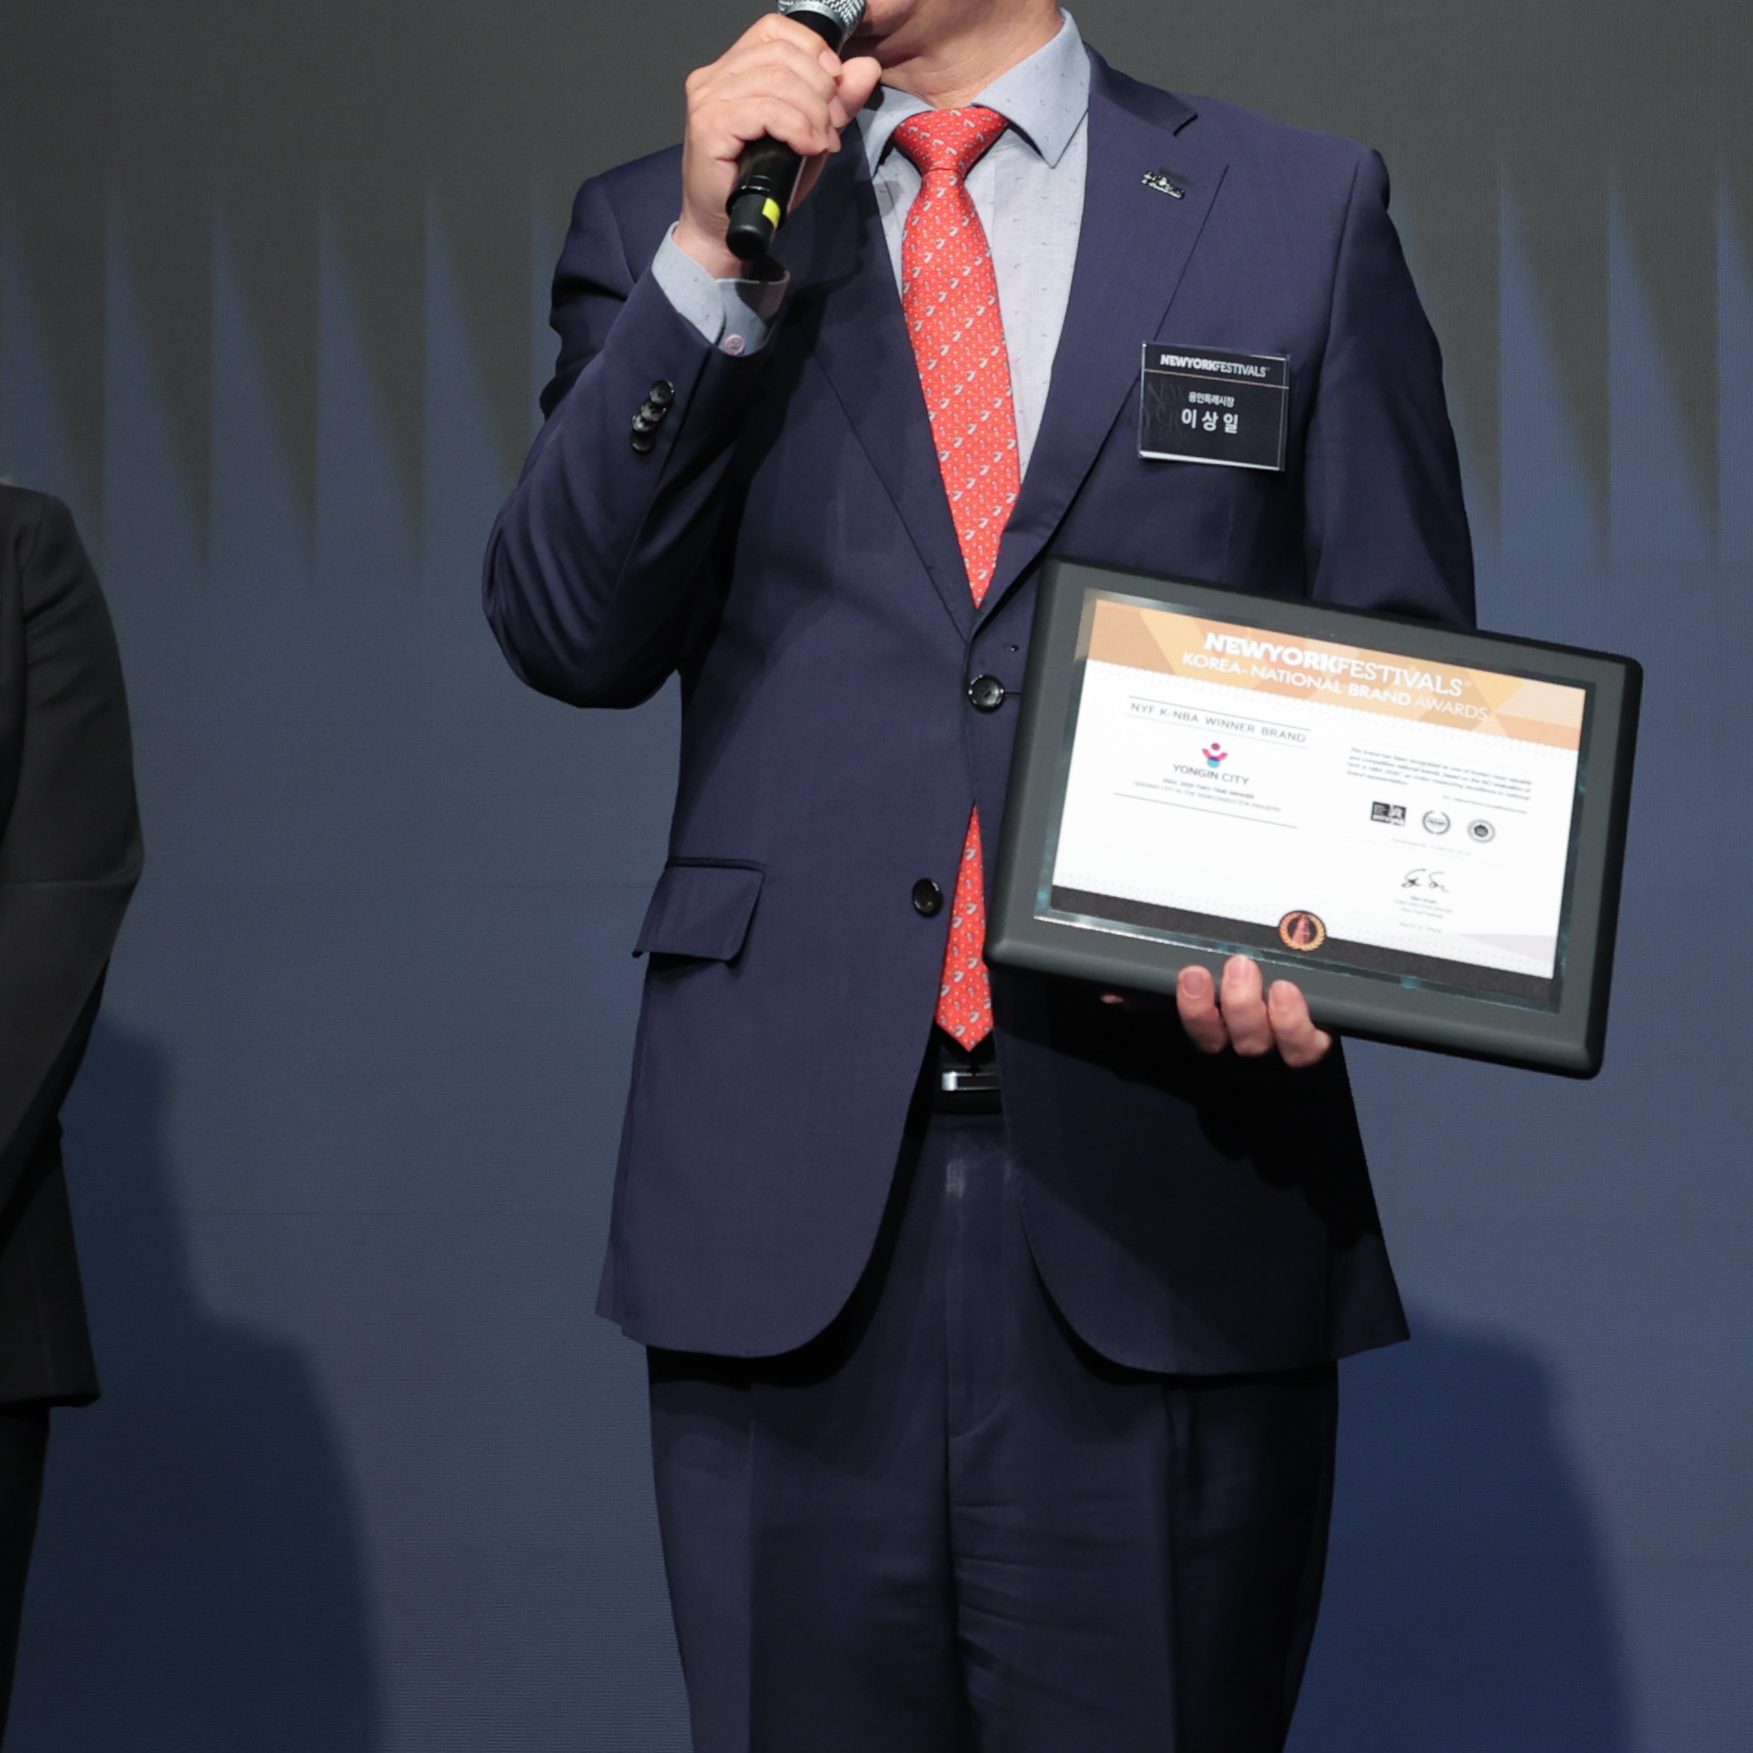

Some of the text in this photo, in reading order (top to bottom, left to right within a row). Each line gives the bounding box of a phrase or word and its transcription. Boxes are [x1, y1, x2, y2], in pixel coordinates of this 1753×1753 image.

[1250, 664, 1342, 694] NATIONAL
[1348, 682, 1411, 706] BRAND
[1413, 696, 1489, 721] AWARDS
[1131, 702, 1306, 743] NYF K-NBA WINNER BRAND
[1173, 764, 1250, 786] YONGIN CITY
